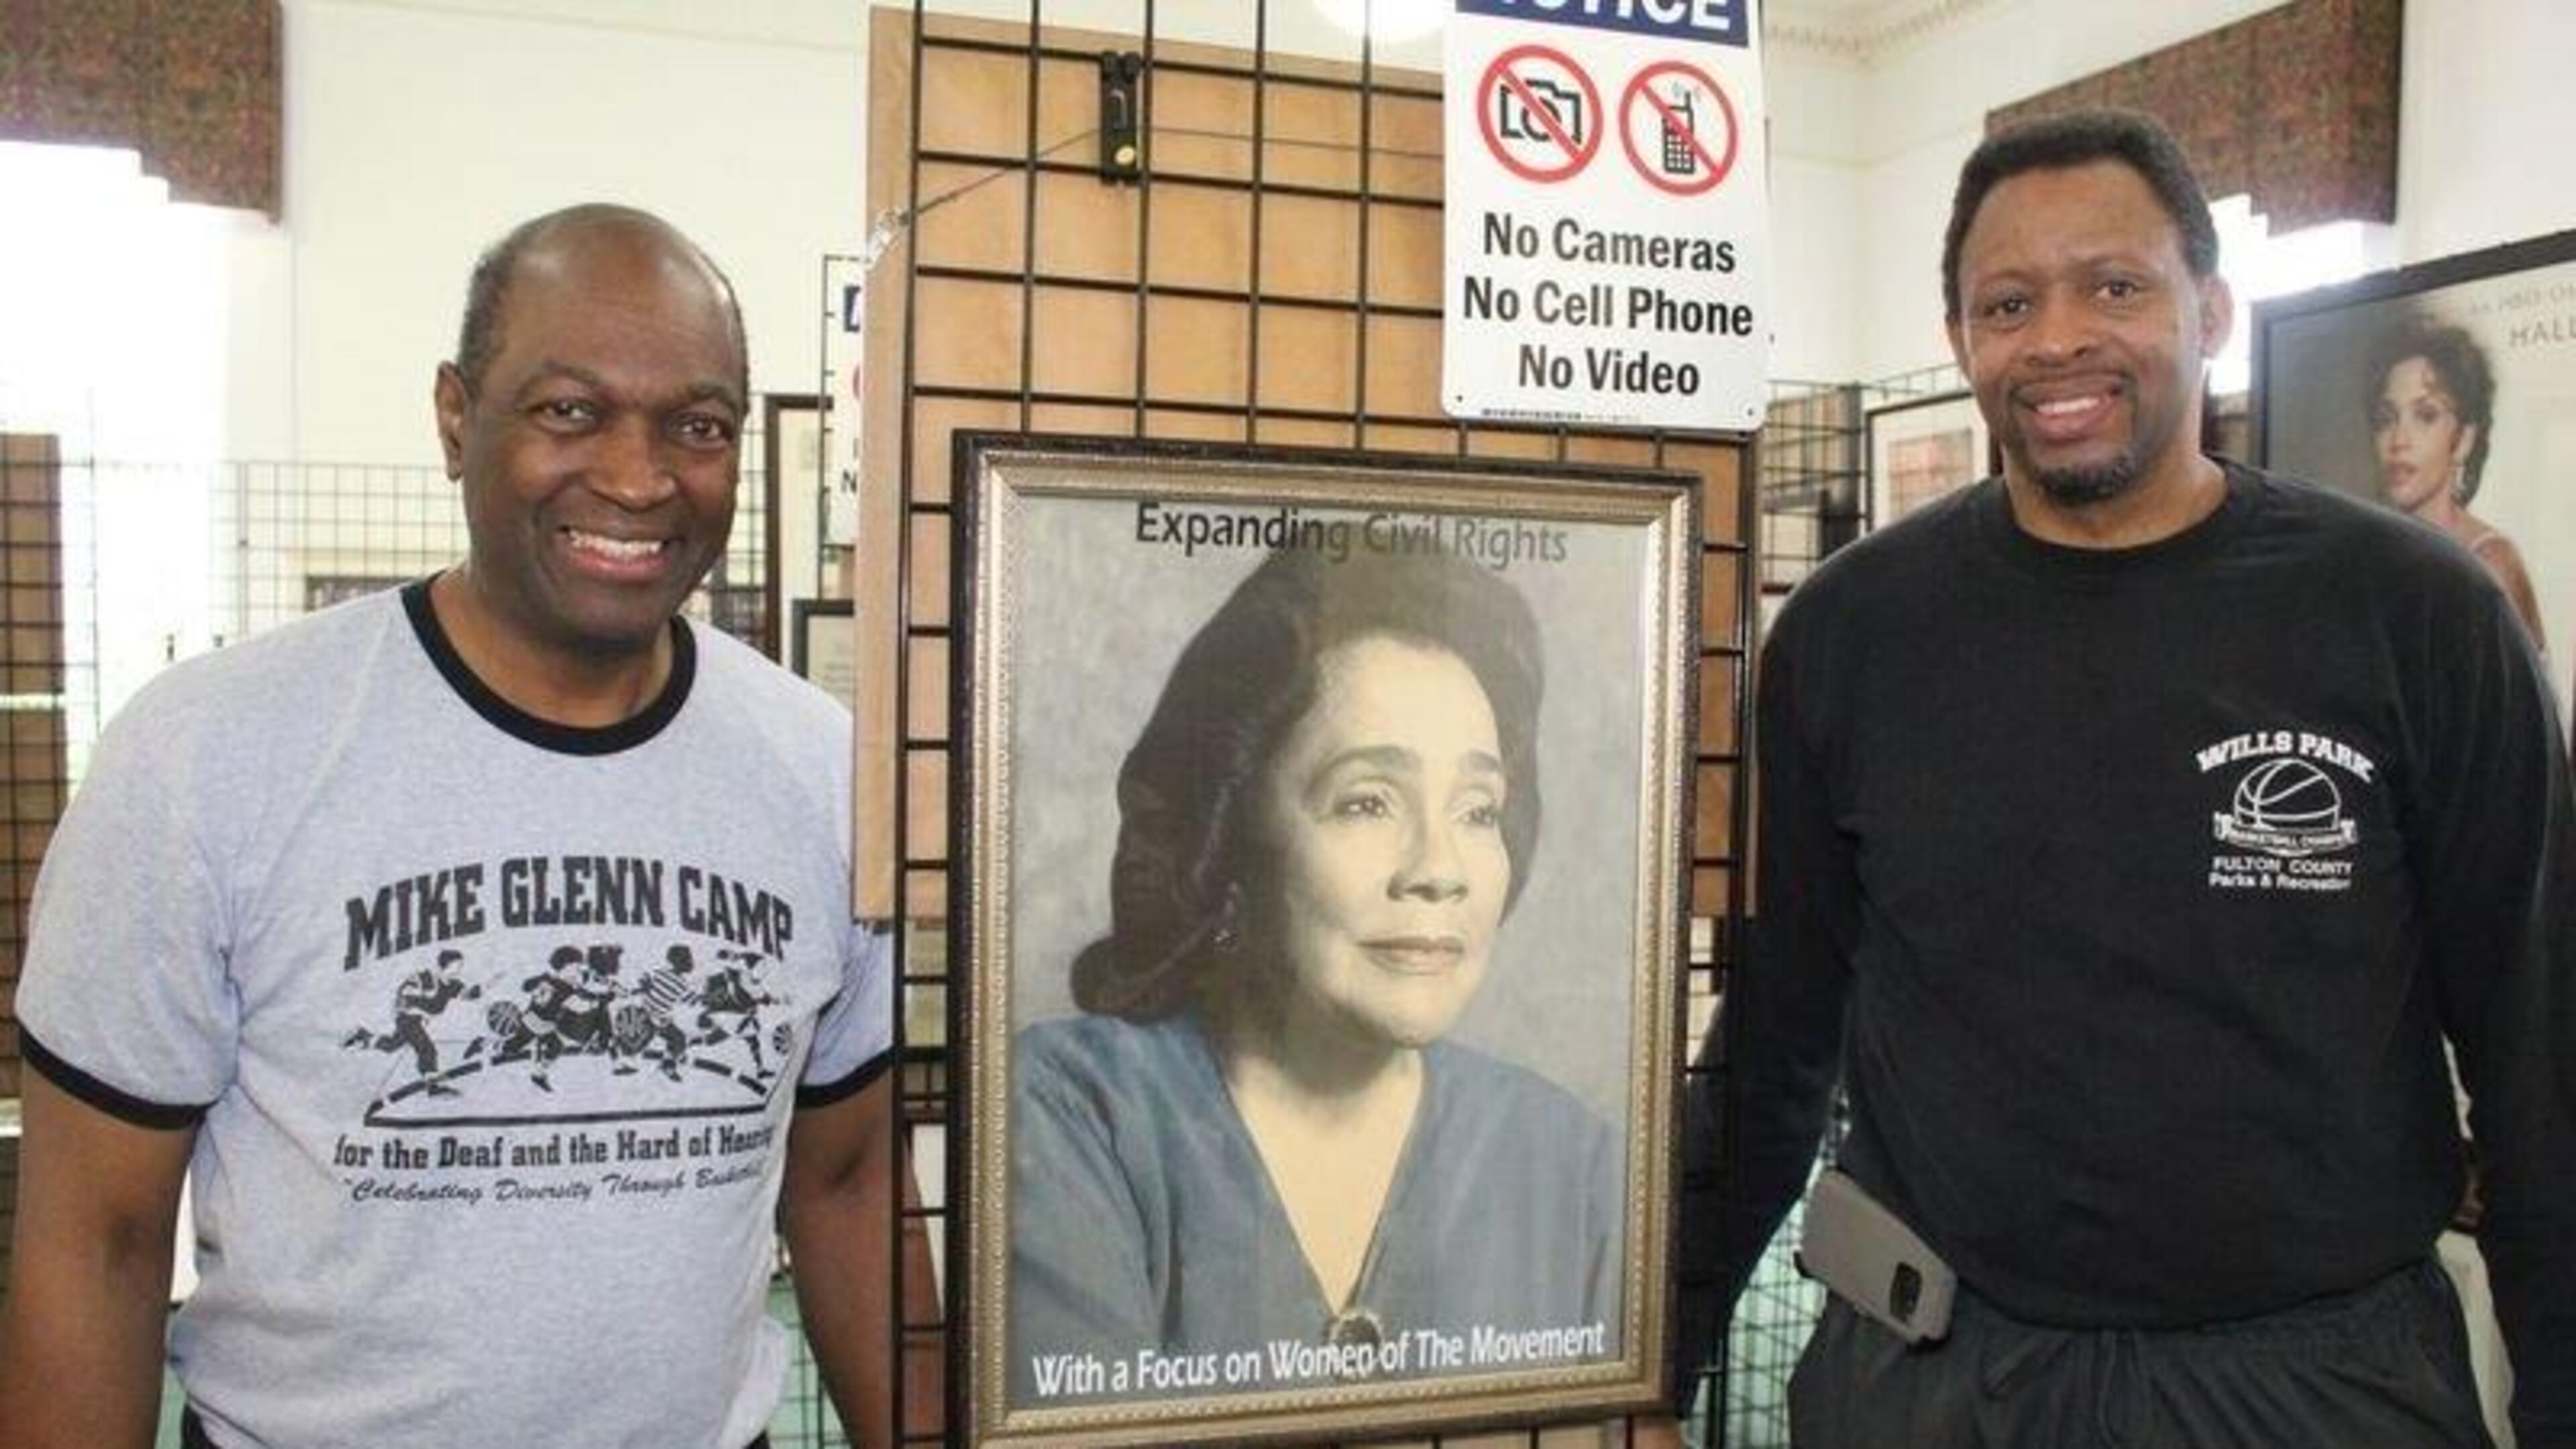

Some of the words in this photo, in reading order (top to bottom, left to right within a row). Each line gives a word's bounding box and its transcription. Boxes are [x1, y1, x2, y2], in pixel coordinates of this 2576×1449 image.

[1484, 212, 1539, 259] No
[1552, 219, 1736, 274] Cameras
[1464, 276, 1519, 322] No
[1534, 280, 1613, 327] Cell
[1628, 287, 1754, 337] Phone
[1519, 343, 1573, 390] No
[1587, 347, 1700, 396] Video
[1136, 502, 1350, 563] Expanding
[1363, 513, 1441, 555] Civil
[1455, 516, 1567, 570] Rights
[2195, 731, 2293, 772] WILLS
[2299, 733, 2374, 784] PARK
[2208, 872, 2257, 887] Parks
[2213, 856, 2280, 871] FULTON
[2289, 859, 2352, 874] COUNTY
[343, 863, 485, 971] MIKE
[500, 855, 665, 928] GLENN
[678, 865, 793, 961] CAMP
[333, 1133, 374, 1167] for
[382, 1138, 429, 1169] the
[437, 1136, 503, 1169] Deaf
[511, 1133, 561, 1167] and
[570, 1132, 608, 1164] the
[616, 1128, 680, 1160] Hard
[688, 1126, 712, 1157] of
[494, 1179, 592, 1201] Diversity
[601, 1169, 685, 1197] Through
[1033, 1353, 1104, 1395] With
[1112, 1360, 1128, 1390] a
[1139, 1350, 1217, 1389] Focus
[1225, 1351, 1260, 1382] on
[1268, 1340, 1373, 1381] Women
[1380, 1332, 1410, 1371] of
[1415, 1329, 1462, 1368] The
[1470, 1321, 1605, 1364] Movement
